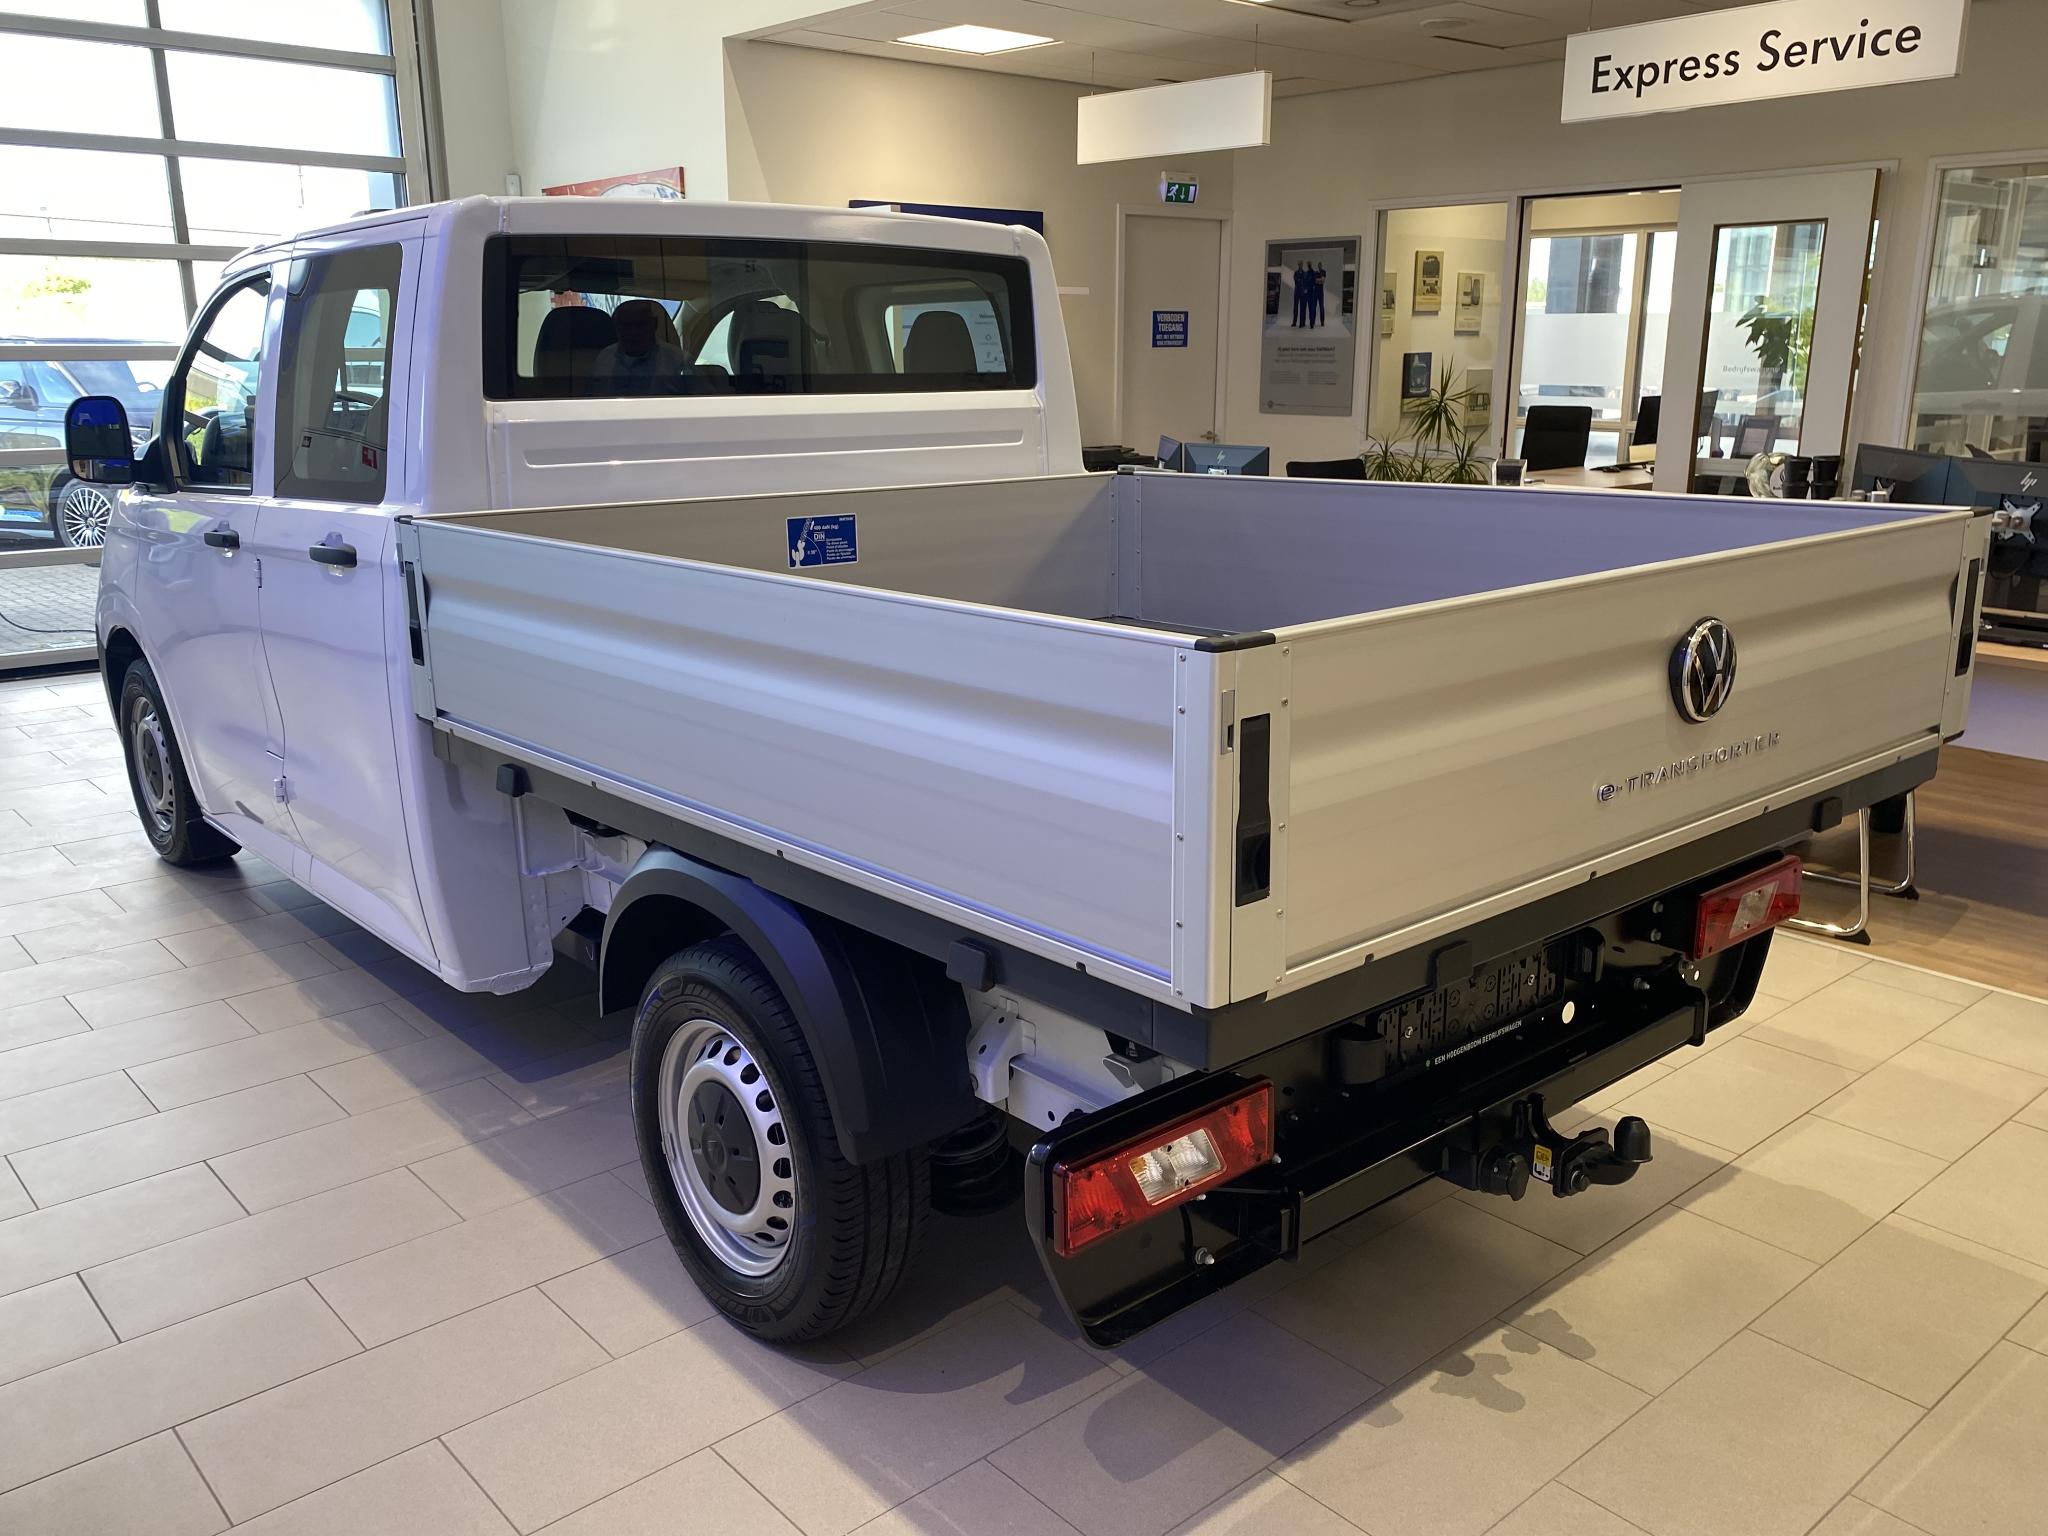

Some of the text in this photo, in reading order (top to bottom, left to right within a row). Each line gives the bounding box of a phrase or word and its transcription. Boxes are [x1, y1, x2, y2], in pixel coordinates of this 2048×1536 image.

[1591, 18, 1921, 98] Express Service
[2019, 471, 2038, 492] hp
[1434, 1054, 1446, 1065] EEN
